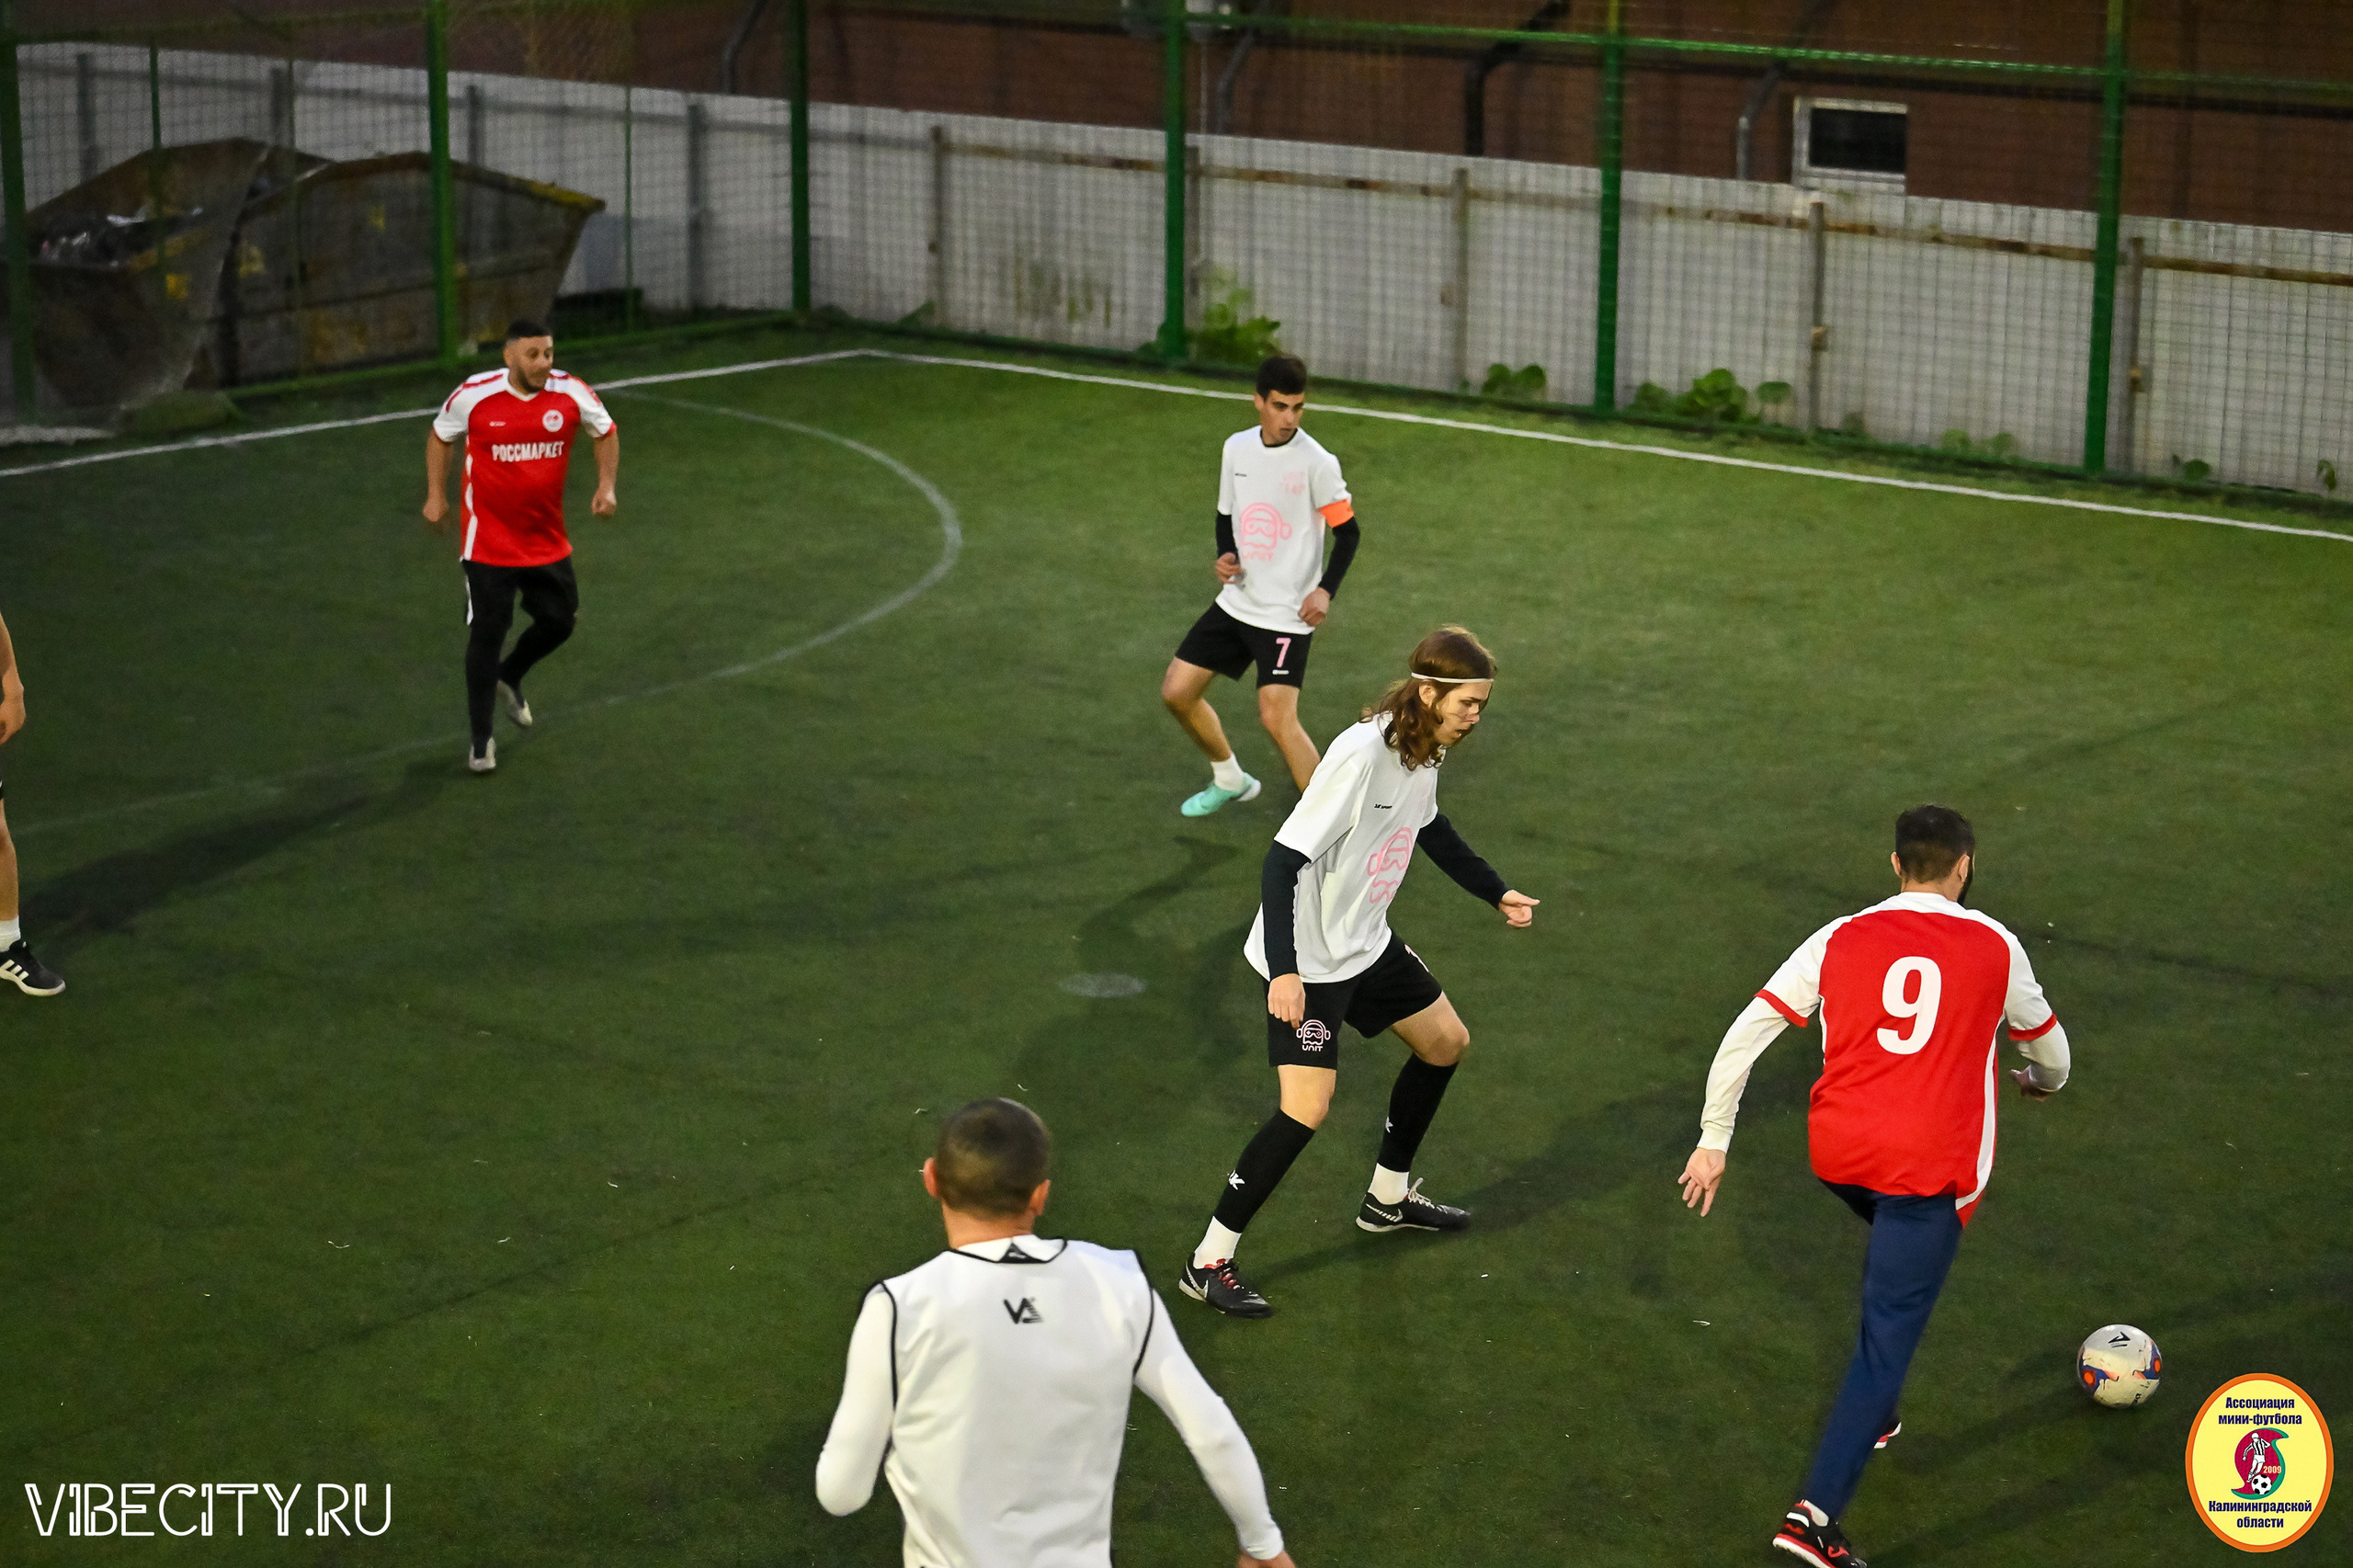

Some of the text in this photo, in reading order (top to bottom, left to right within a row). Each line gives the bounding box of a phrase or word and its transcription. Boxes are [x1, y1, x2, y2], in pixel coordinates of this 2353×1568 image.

[492, 441, 564, 462] РОССМАРКЕТ
[1276, 637, 1291, 668] 7
[1877, 956, 1942, 1055] 9
[1302, 1044, 1324, 1052] UNIT
